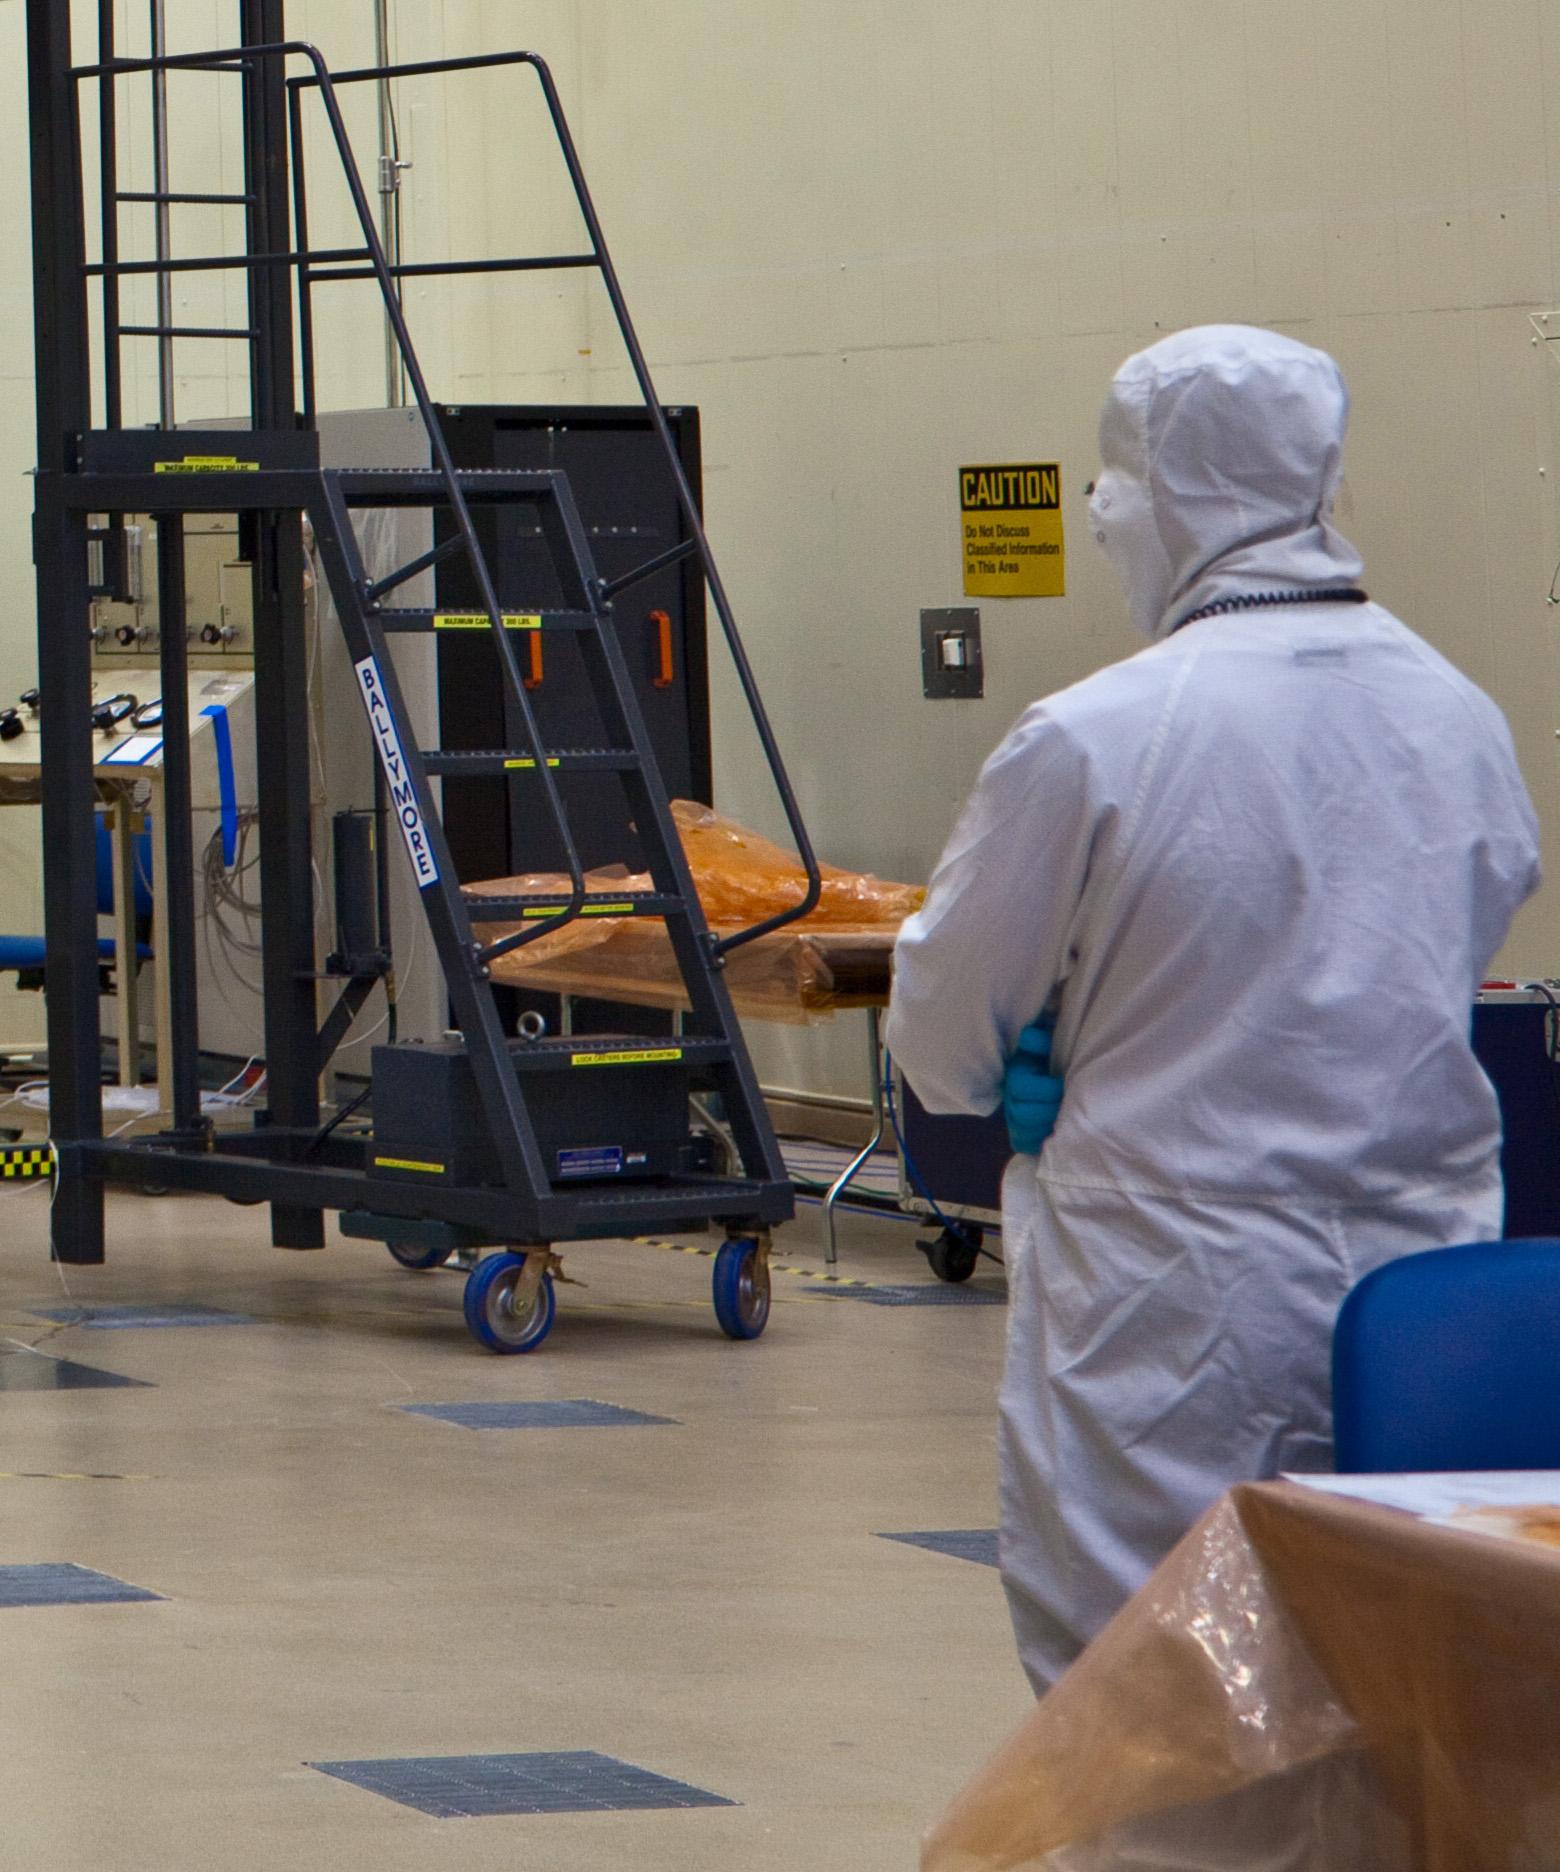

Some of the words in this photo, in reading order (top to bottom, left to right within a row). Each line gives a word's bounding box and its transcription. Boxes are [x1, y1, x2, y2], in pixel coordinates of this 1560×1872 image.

[963, 471, 1057, 506] CAUTION
[966, 525, 977, 538] Do
[979, 525, 994, 538] Not
[997, 524, 1030, 538] Discuss
[967, 543, 1008, 556] Classified
[1010, 542, 1060, 556] Information
[967, 562, 976, 574] in
[979, 561, 996, 574] This
[999, 560, 1019, 574] Area
[362, 668, 430, 875] BALLYMORE
